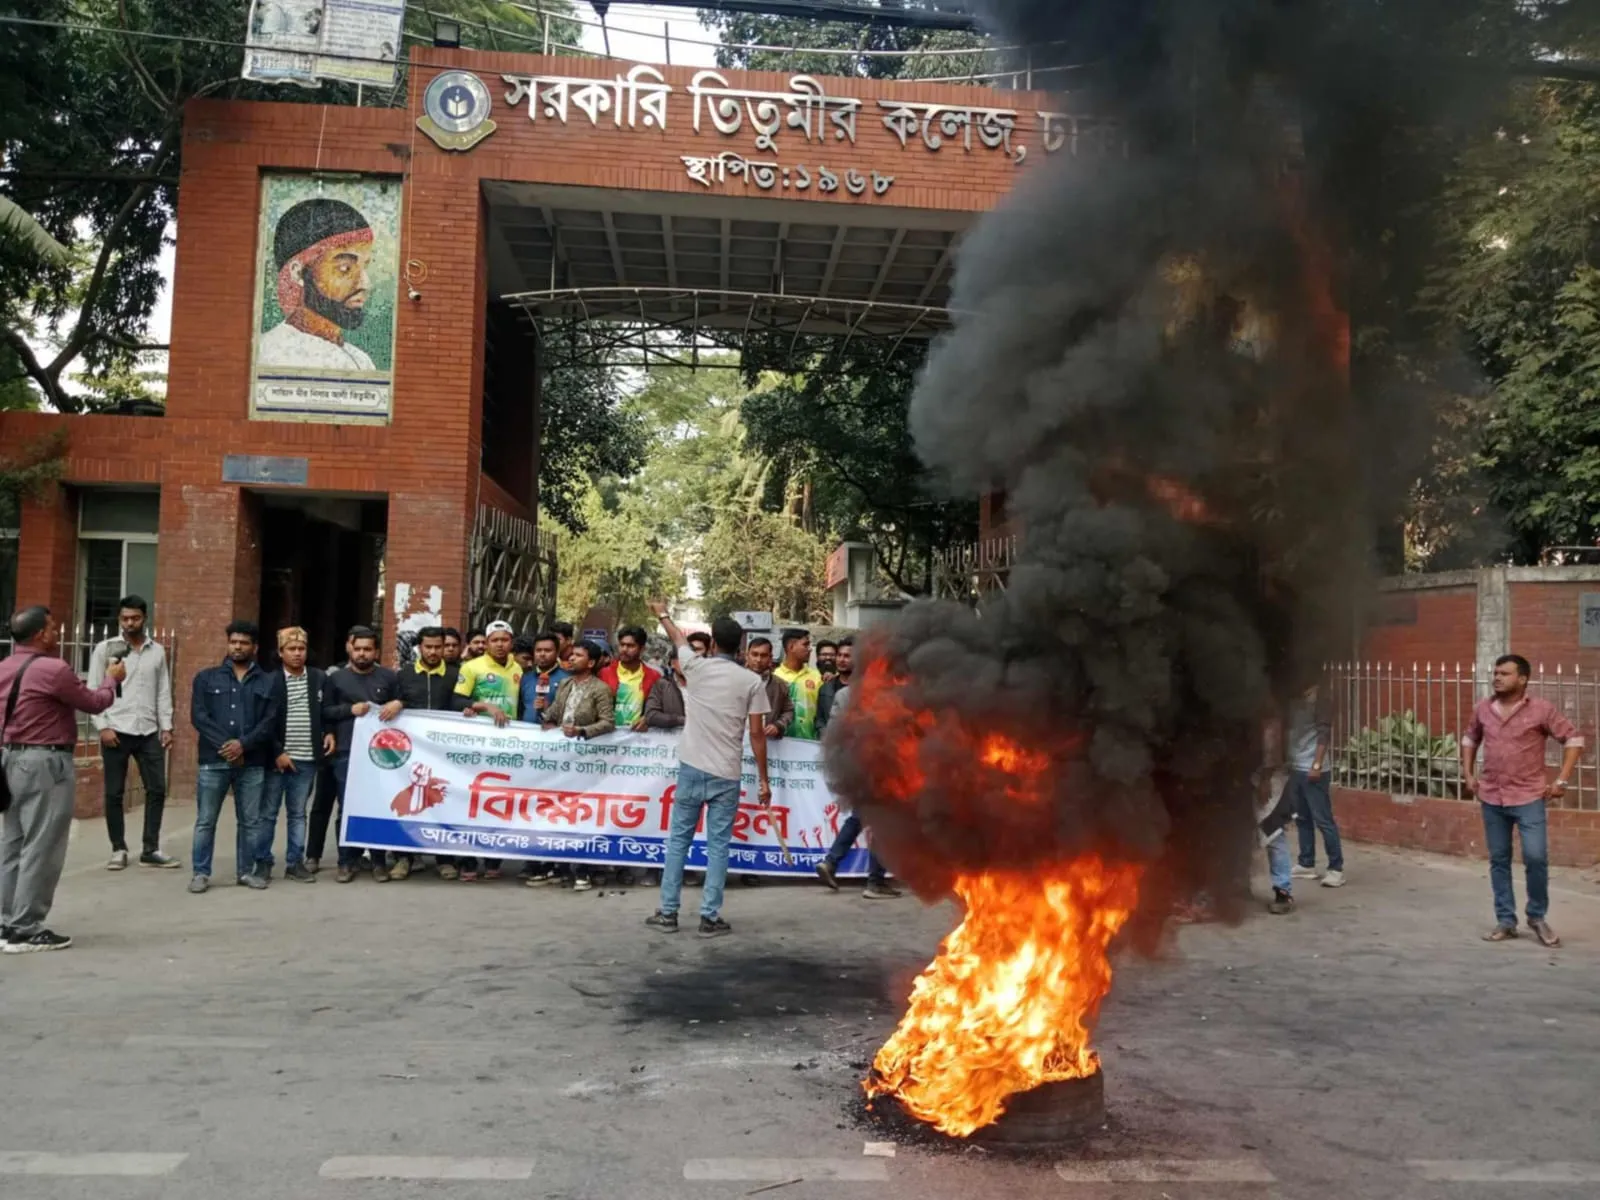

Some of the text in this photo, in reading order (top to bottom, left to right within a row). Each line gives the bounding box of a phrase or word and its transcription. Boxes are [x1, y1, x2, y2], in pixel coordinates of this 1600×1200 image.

[501, 65, 672, 131] সরকারি
[687, 70, 862, 153] তিতুমীর
[877, 100, 1027, 164] কলেজ,
[426, 730, 486, 747] বাংলাদেশ
[490, 736, 570, 753] জাতীয়তাবাদী
[574, 742, 618, 756] ছাত্রদল
[621, 744, 667, 759] সরকারি
[446, 751, 481, 766] পকেট
[485, 752, 525, 769] কমিটি
[529, 755, 557, 771] গঠন
[560, 761, 571, 772] ও
[575, 759, 607, 774] ত্যাগী
[468, 771, 650, 829] বিক্ষোভ
[421, 828, 530, 848] আয়োজনেঃ
[537, 835, 611, 854] সরকারি
[618, 836, 695, 861] তিতু
